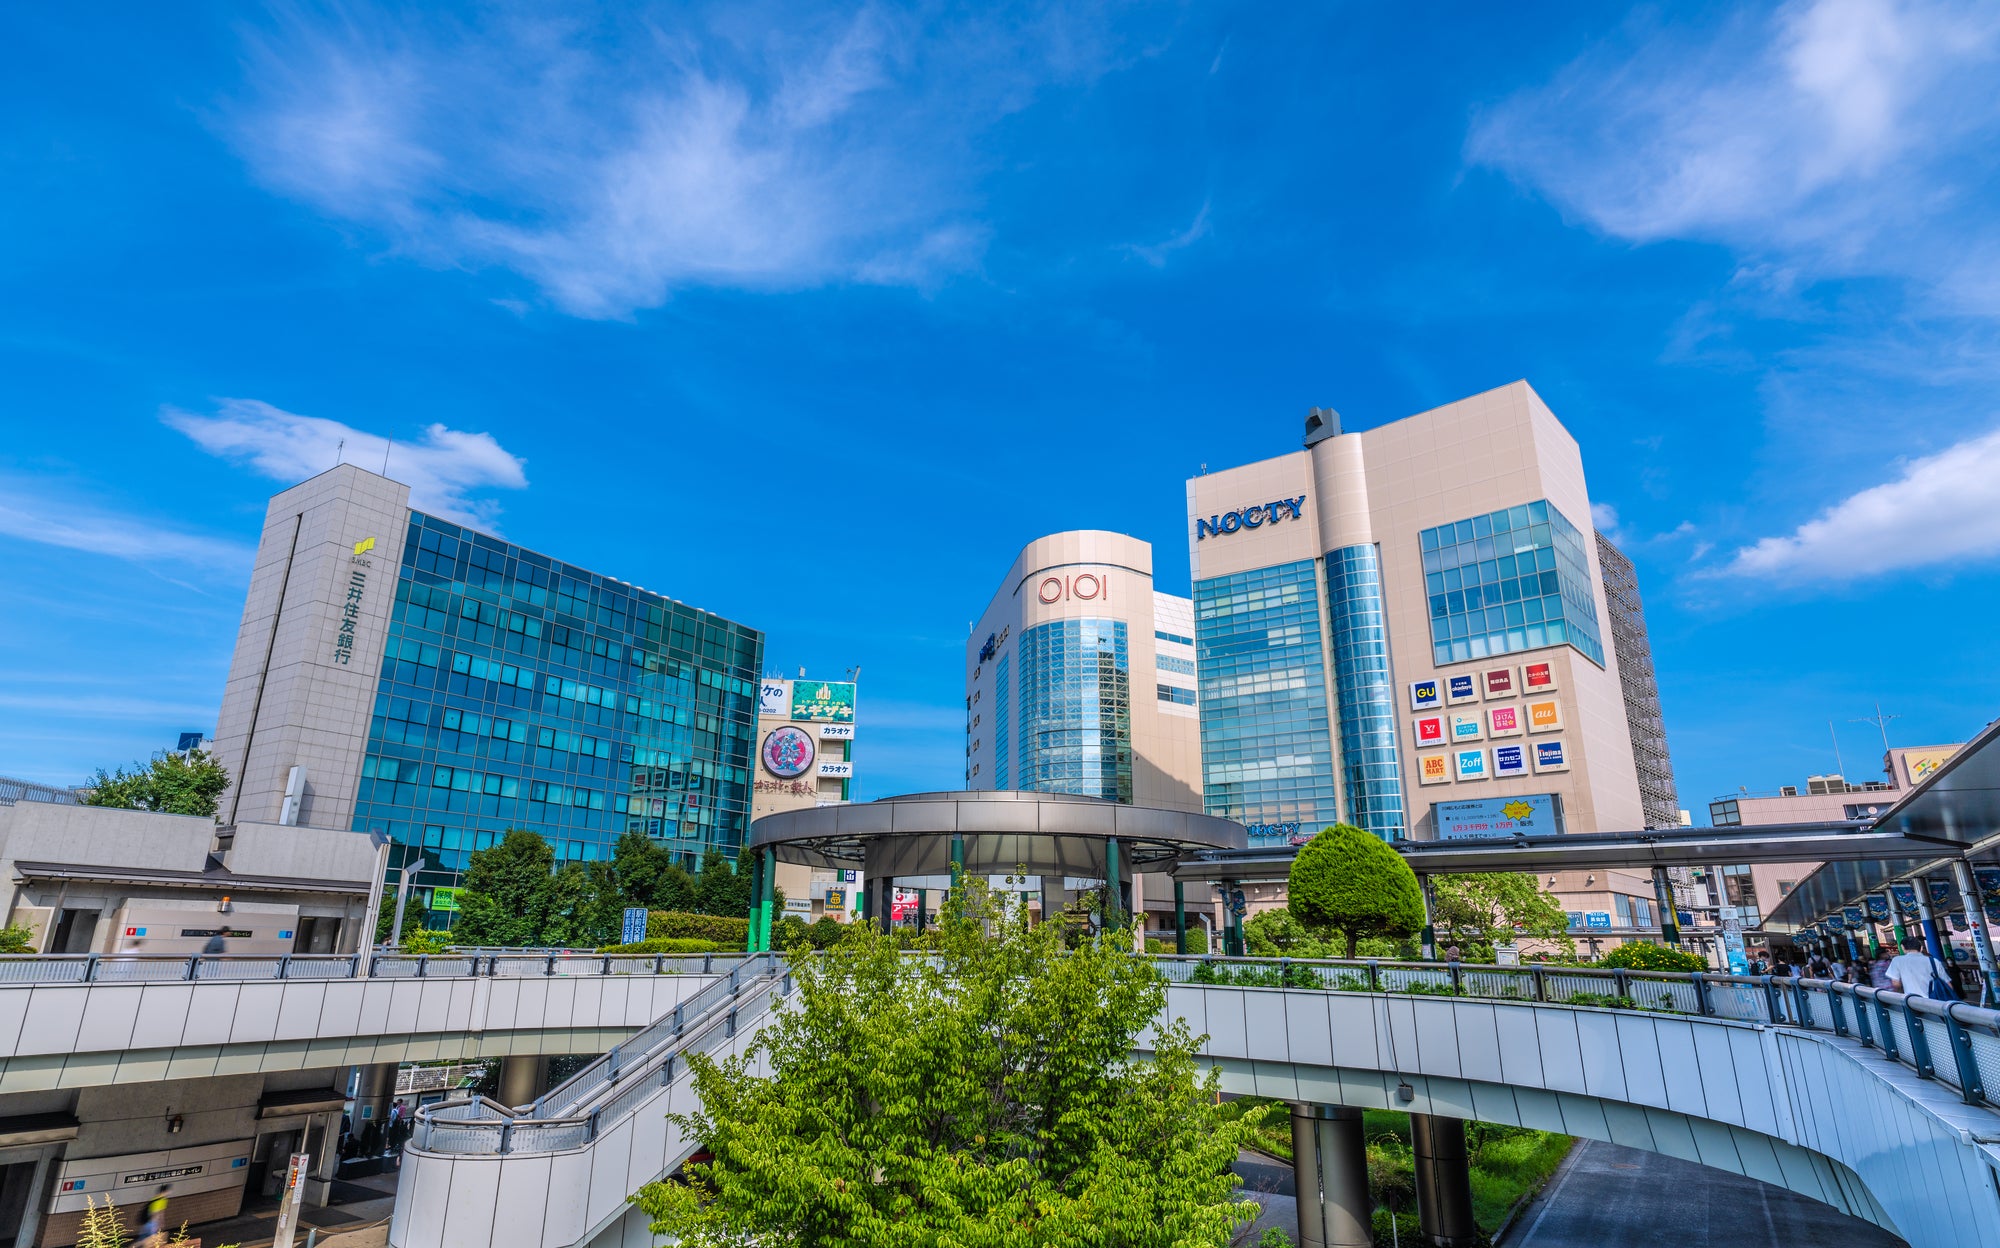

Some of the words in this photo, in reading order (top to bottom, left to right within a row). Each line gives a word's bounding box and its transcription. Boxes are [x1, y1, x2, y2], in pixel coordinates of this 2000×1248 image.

[1197, 495, 1306, 539] NOCTY
[334, 571, 366, 665] 三井住友銀行
[1417, 687, 1435, 698] GU
[793, 704, 853, 718] スギザキ
[823, 727, 850, 735] カラオケ
[1425, 758, 1443, 769] ABC
[1461, 757, 1481, 768] Zoff
[821, 765, 849, 773] カラオケ
[1426, 767, 1444, 775] MART
[301, 1158, 307, 1166] 7
